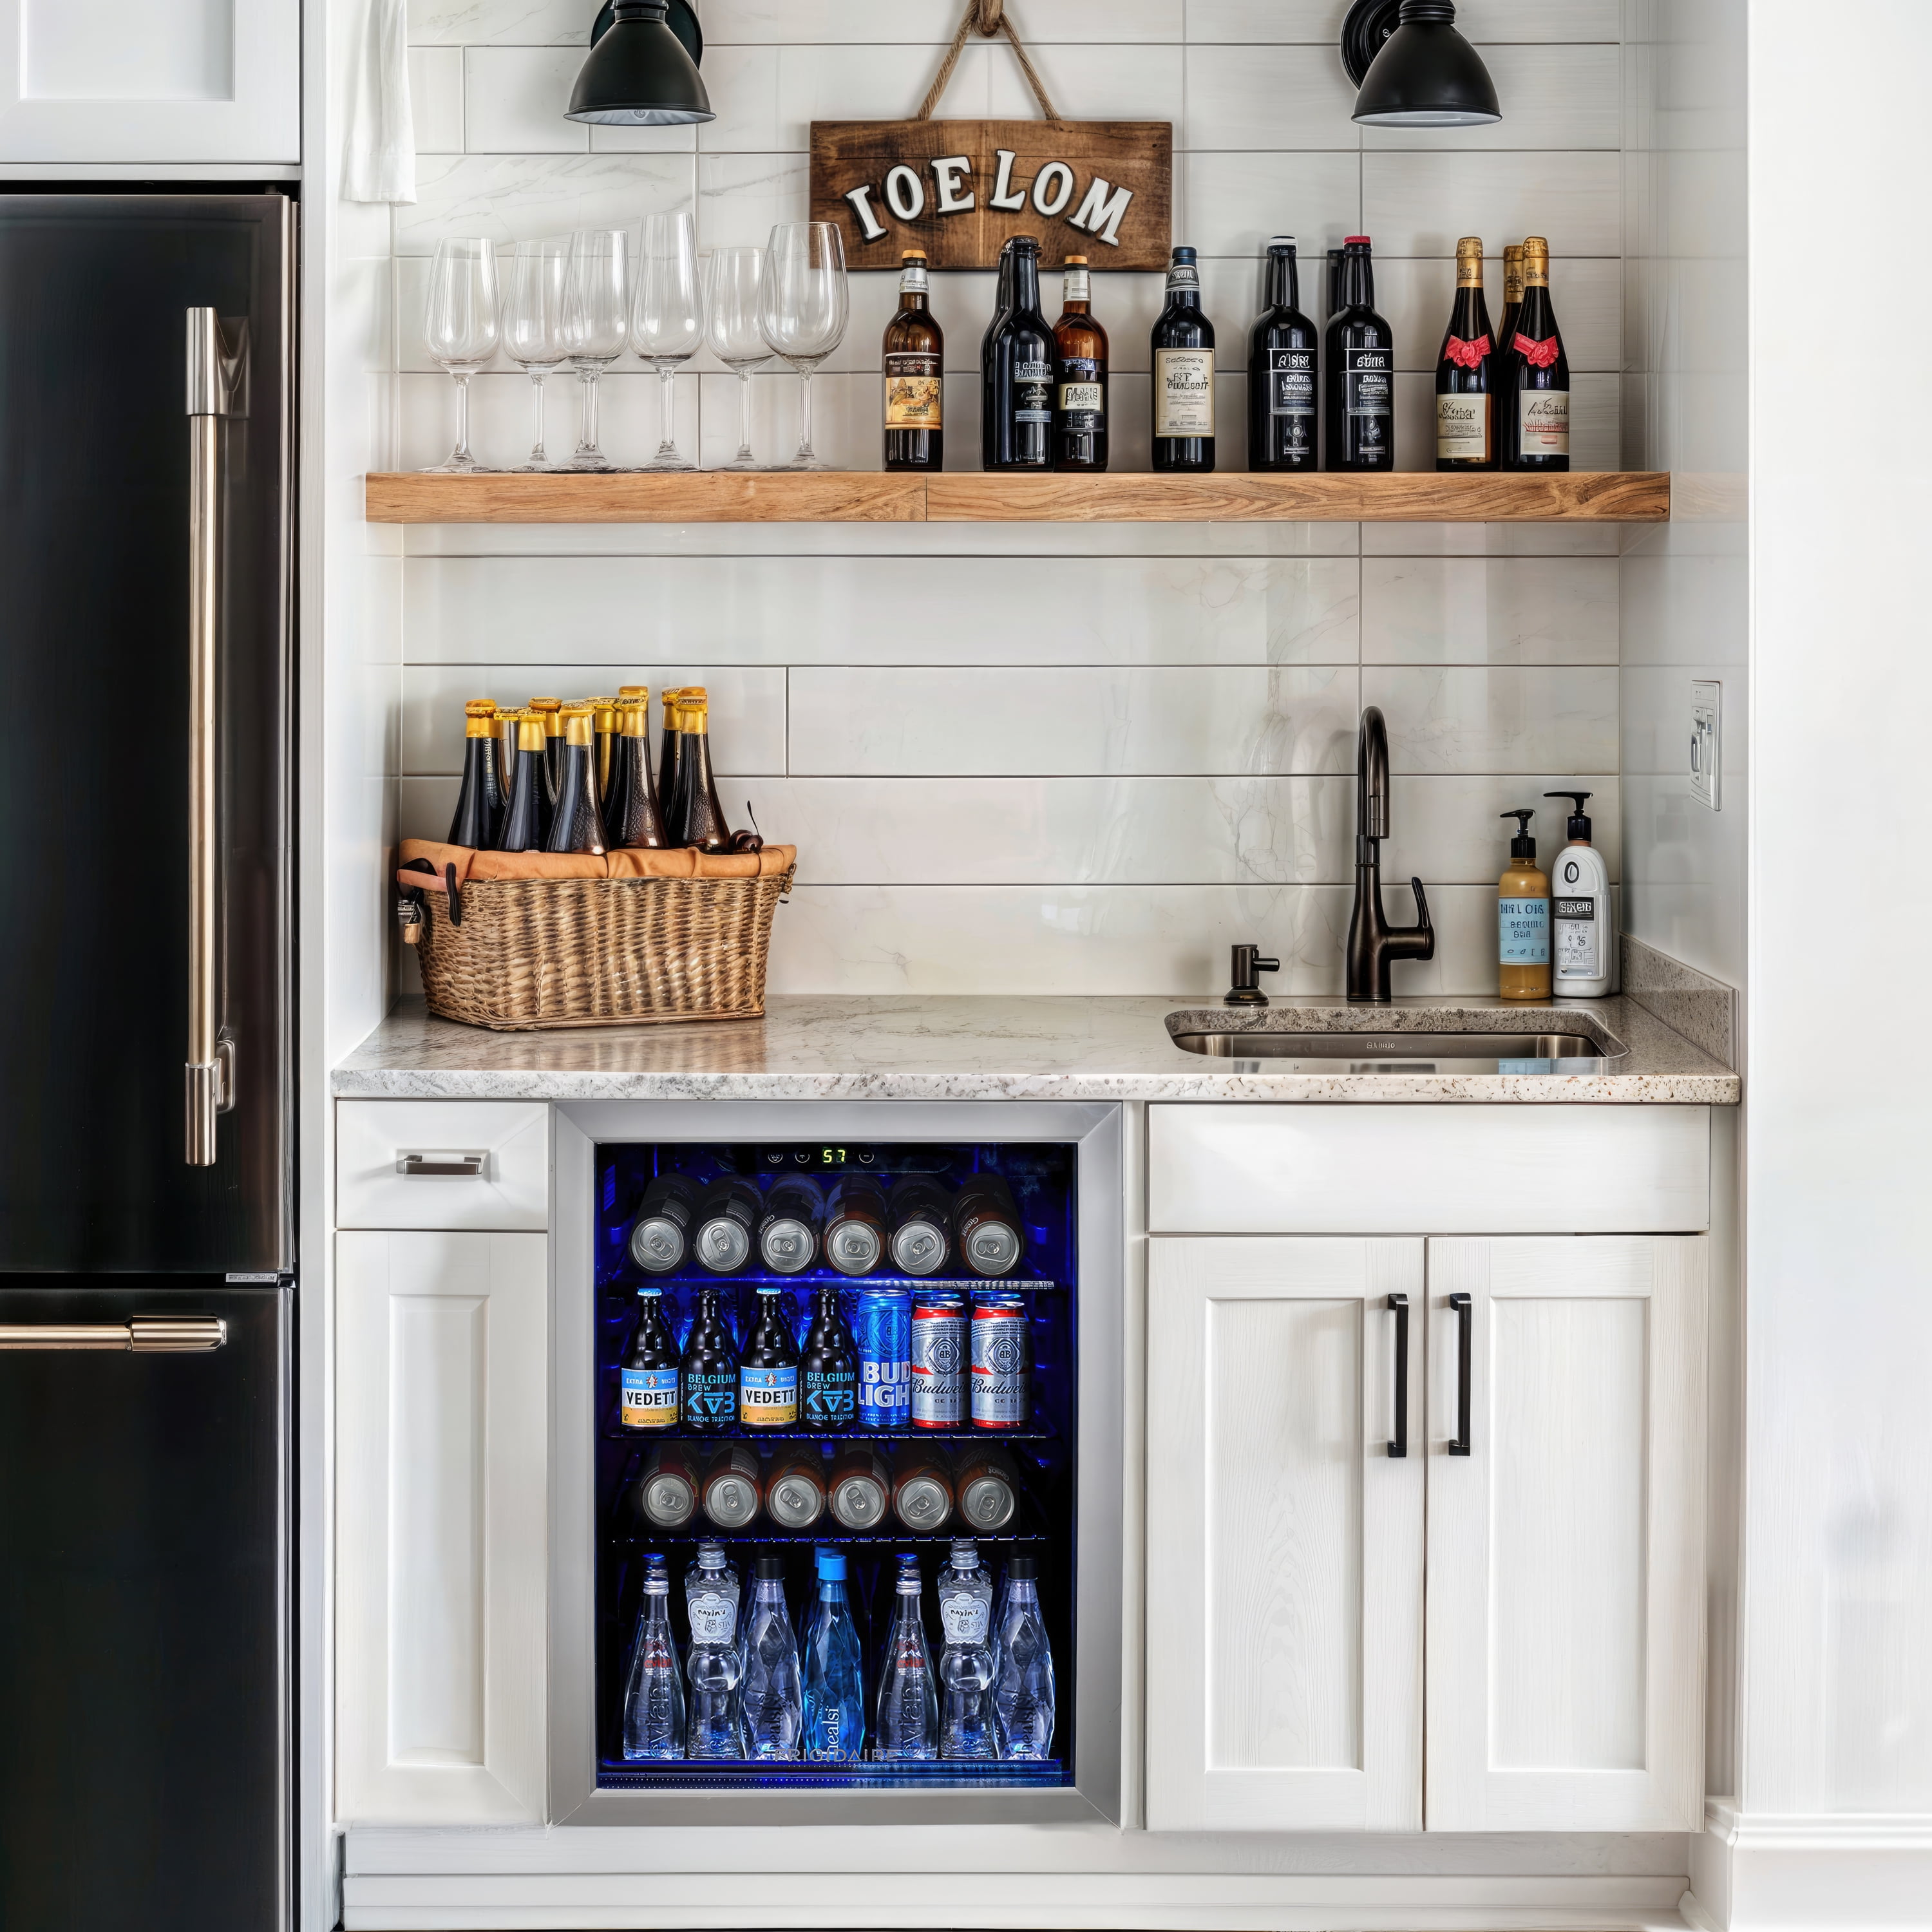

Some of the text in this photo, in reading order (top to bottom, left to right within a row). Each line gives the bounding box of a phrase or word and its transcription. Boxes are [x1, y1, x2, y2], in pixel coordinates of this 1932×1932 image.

[823, 1150, 846, 1163] 57
[688, 1374, 735, 1384] BELGIUM
[807, 1372, 855, 1383] BELGIUM
[626, 1390, 676, 1406] VEDETT
[745, 1388, 795, 1404] VEDETT
[774, 1748, 898, 1763] FRIGIDAIRE
